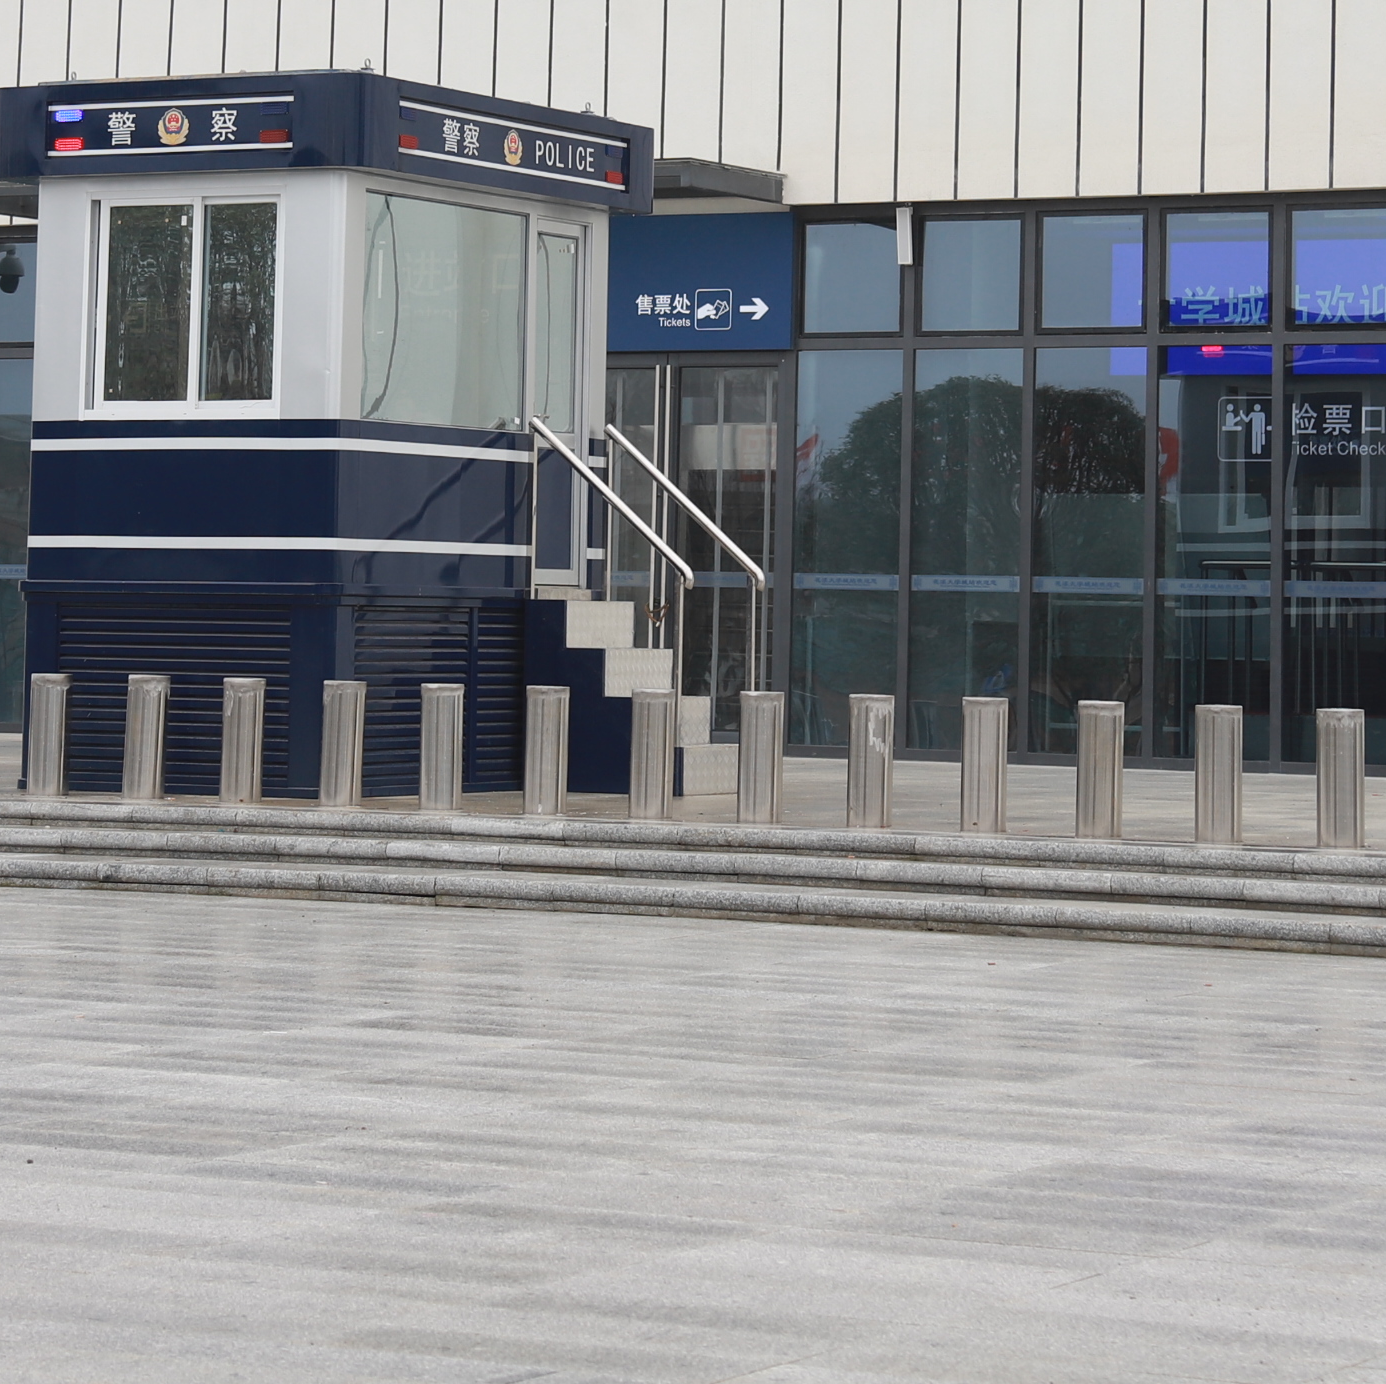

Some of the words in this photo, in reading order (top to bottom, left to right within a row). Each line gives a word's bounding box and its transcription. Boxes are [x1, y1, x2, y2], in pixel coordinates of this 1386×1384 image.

[442, 117, 480, 157] 警察
[535, 139, 595, 173] POLICE
[635, 294, 691, 316] 售票处
[658, 317, 691, 328] Tickets
[1291, 402, 1386, 436] 检票口
[1337, 441, 1386, 456] Check
